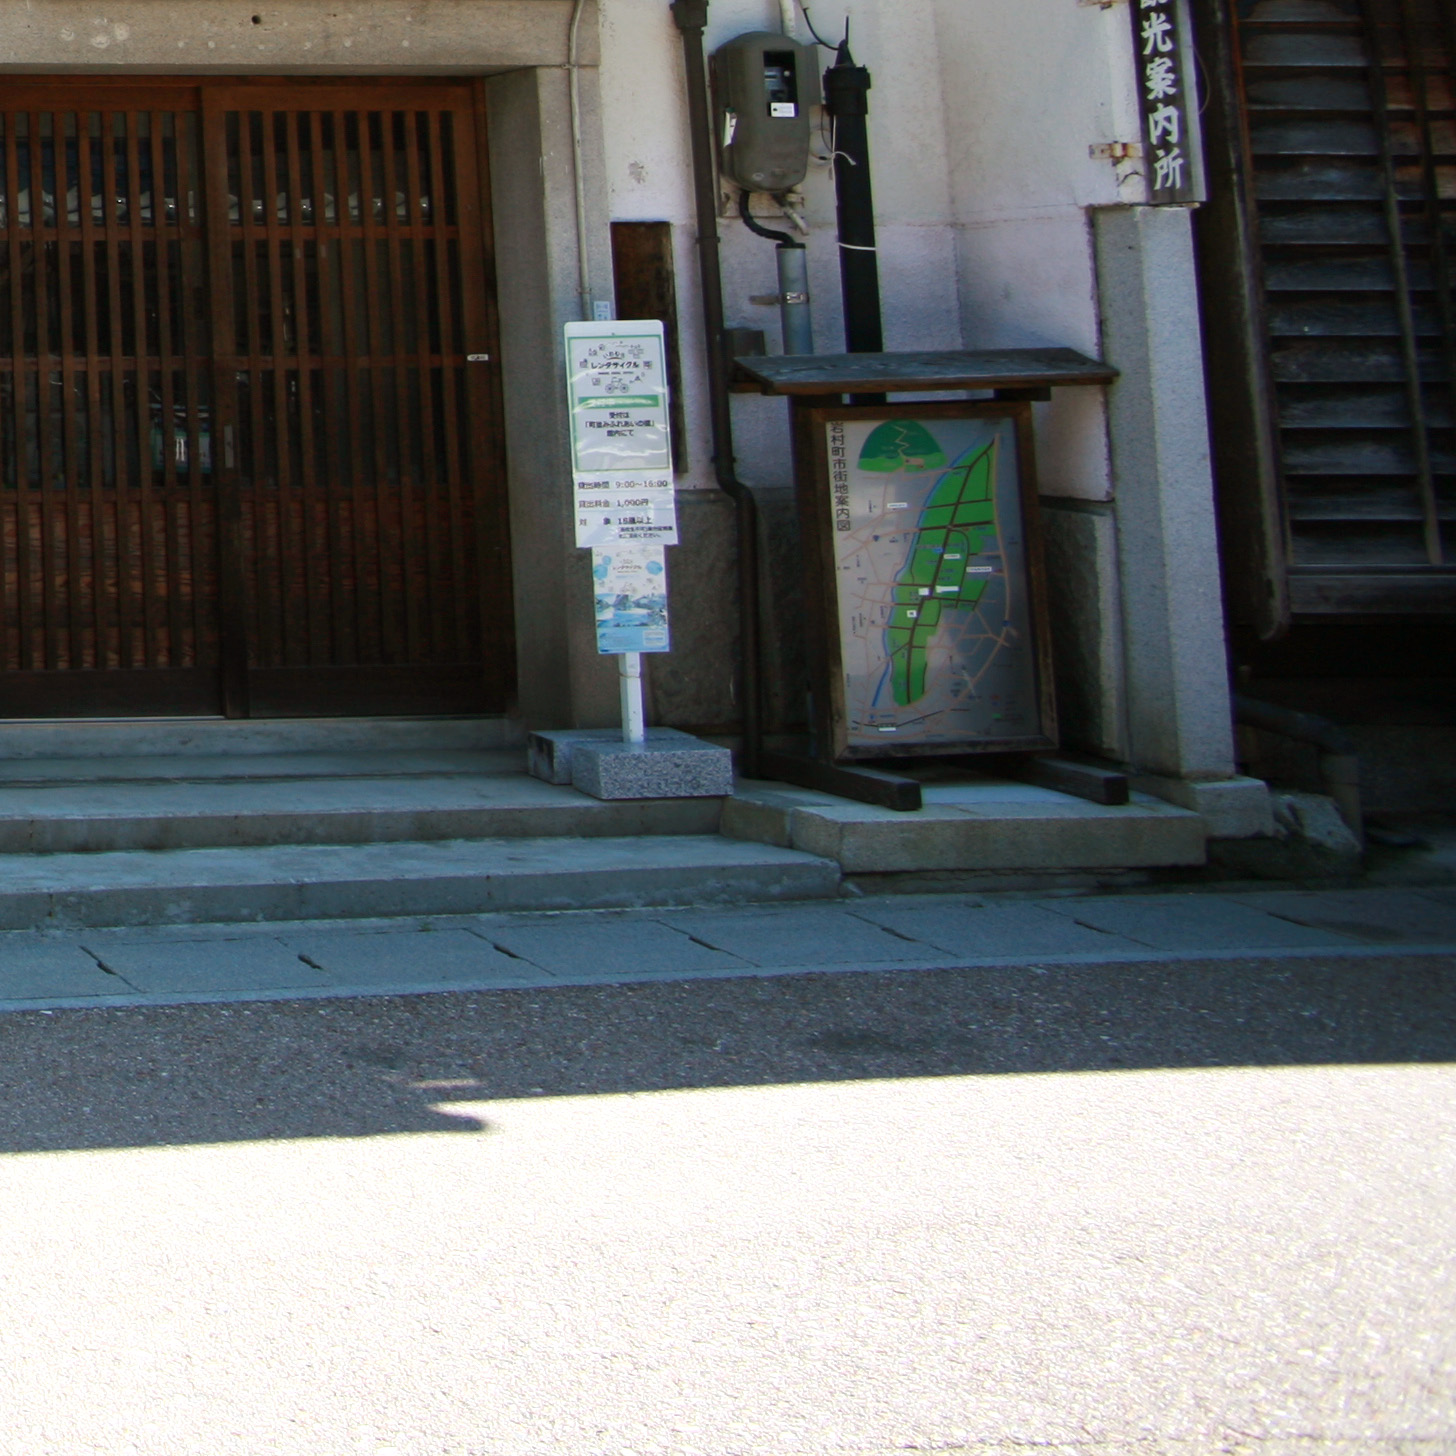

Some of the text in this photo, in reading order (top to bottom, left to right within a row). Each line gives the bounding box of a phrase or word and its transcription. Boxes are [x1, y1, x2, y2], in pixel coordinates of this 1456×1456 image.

[591, 361, 640, 370] レンタサイクル
[577, 481, 610, 490] 貸出時間
